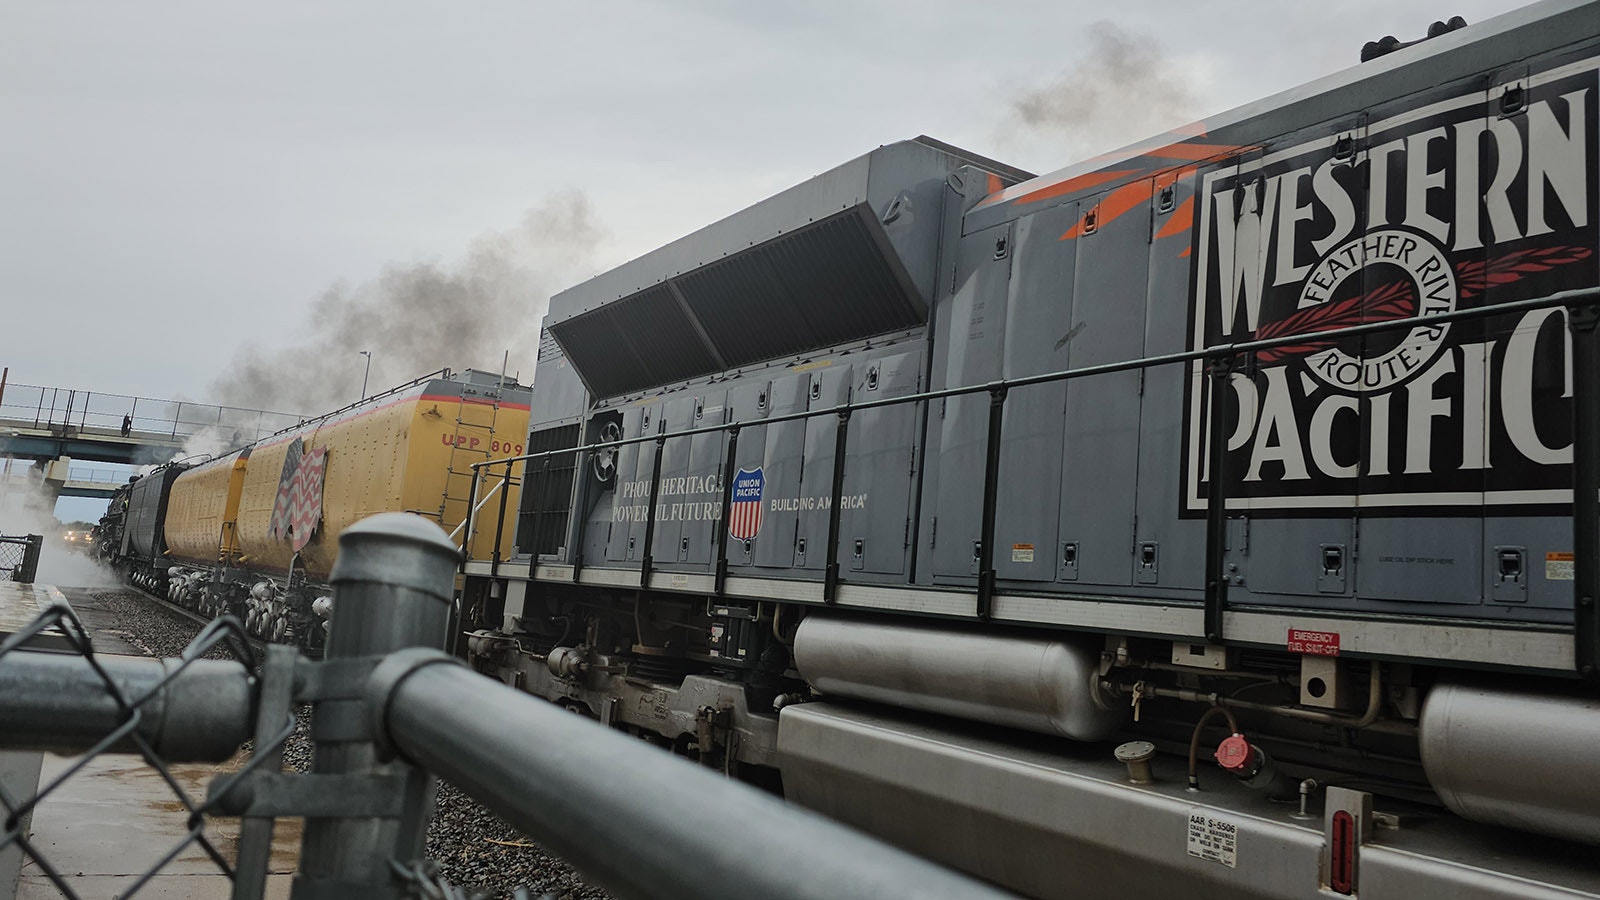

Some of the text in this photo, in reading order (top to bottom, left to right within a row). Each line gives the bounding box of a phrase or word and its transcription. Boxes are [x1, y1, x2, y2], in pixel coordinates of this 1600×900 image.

[1213, 87, 1590, 335] WESTERN
[1303, 235, 1451, 342] FEATHER RIVER
[1317, 347, 1420, 387] ROUTE
[1201, 306, 1574, 483] PACIFIC
[441, 433, 523, 456] UPP 809
[623, 474, 725, 498] PROU HERITAGE
[736, 488, 760, 497] PACIFIC
[738, 479, 760, 488] UNION
[612, 501, 722, 522] POWERUL FUTURE
[770, 497, 814, 512] BUILDING
[1294, 631, 1333, 643] EMERGENCY
[1288, 641, 1339, 655] FUEL SHUT-OFF
[1190, 815, 1236, 833] AAR S-5506
